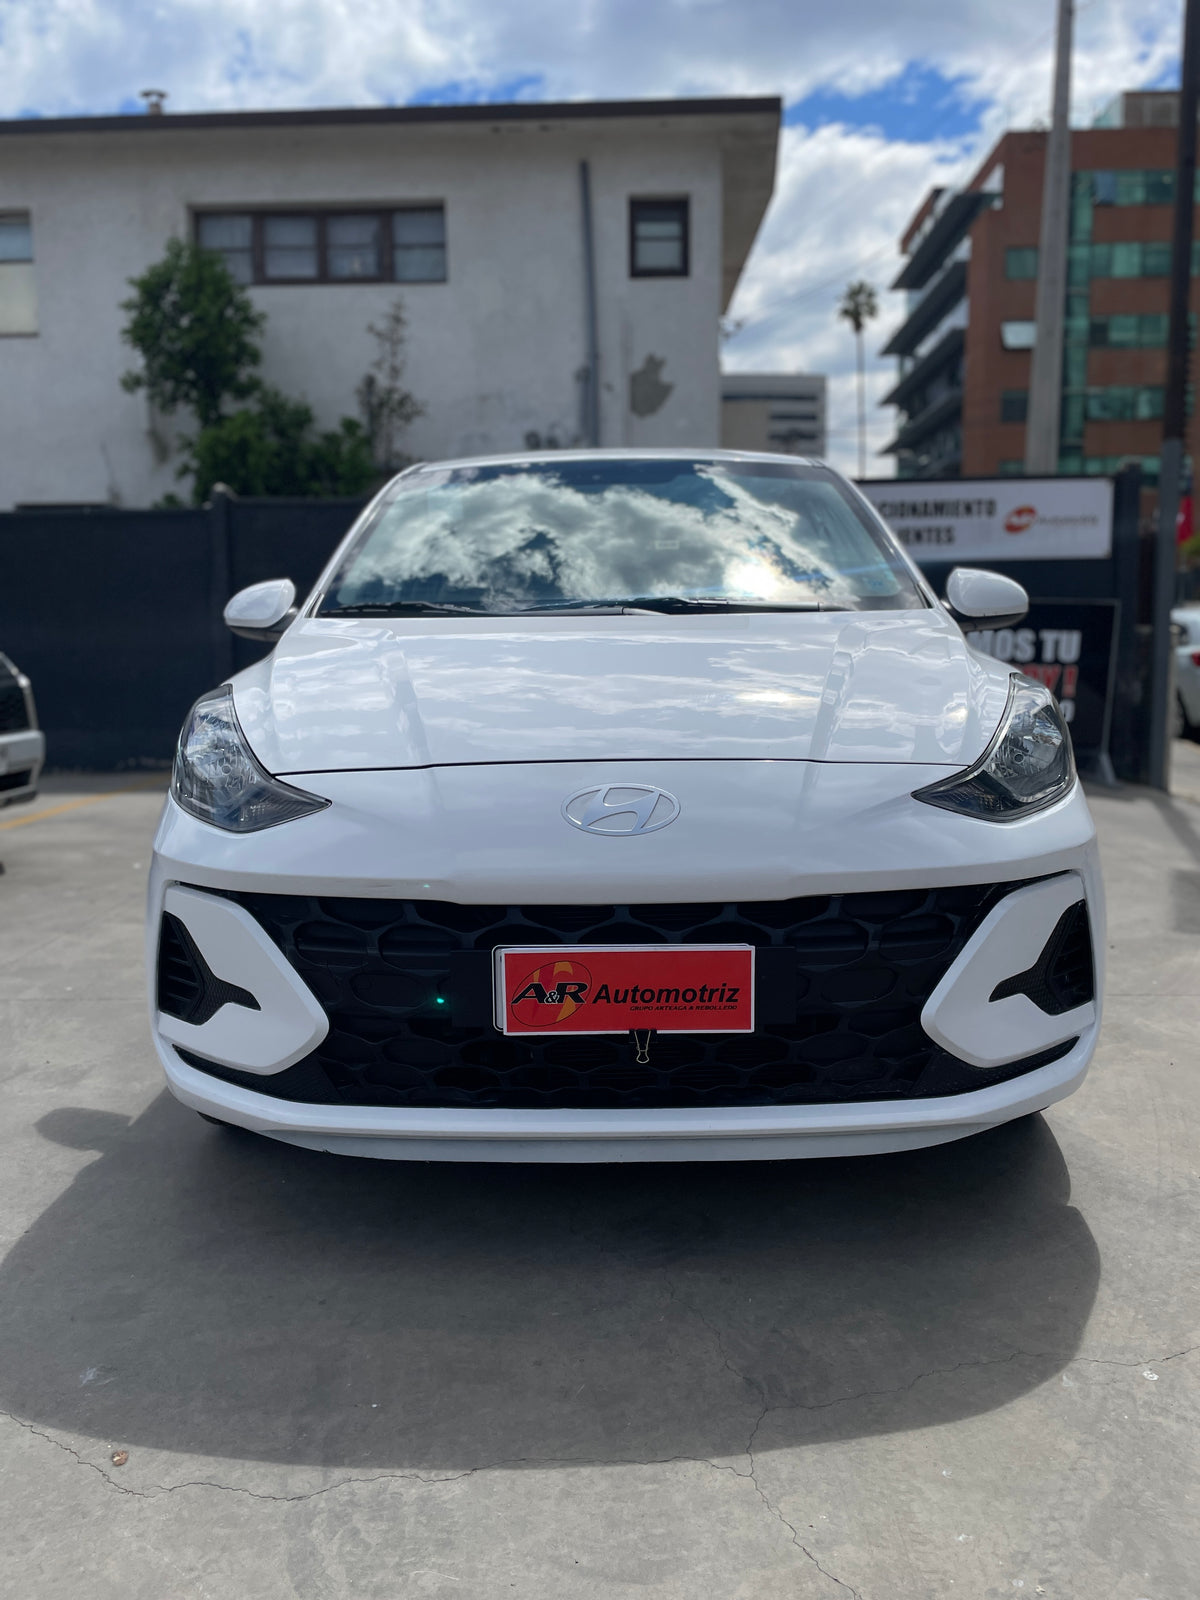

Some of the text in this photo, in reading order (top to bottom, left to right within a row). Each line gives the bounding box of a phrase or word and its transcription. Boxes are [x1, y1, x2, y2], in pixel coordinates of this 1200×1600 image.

[878, 498, 997, 518] CIONAMIENTO
[897, 526, 955, 545] IENTES
[1039, 629, 1082, 663] TU
[510, 982, 740, 1005] A&R Automotriz
